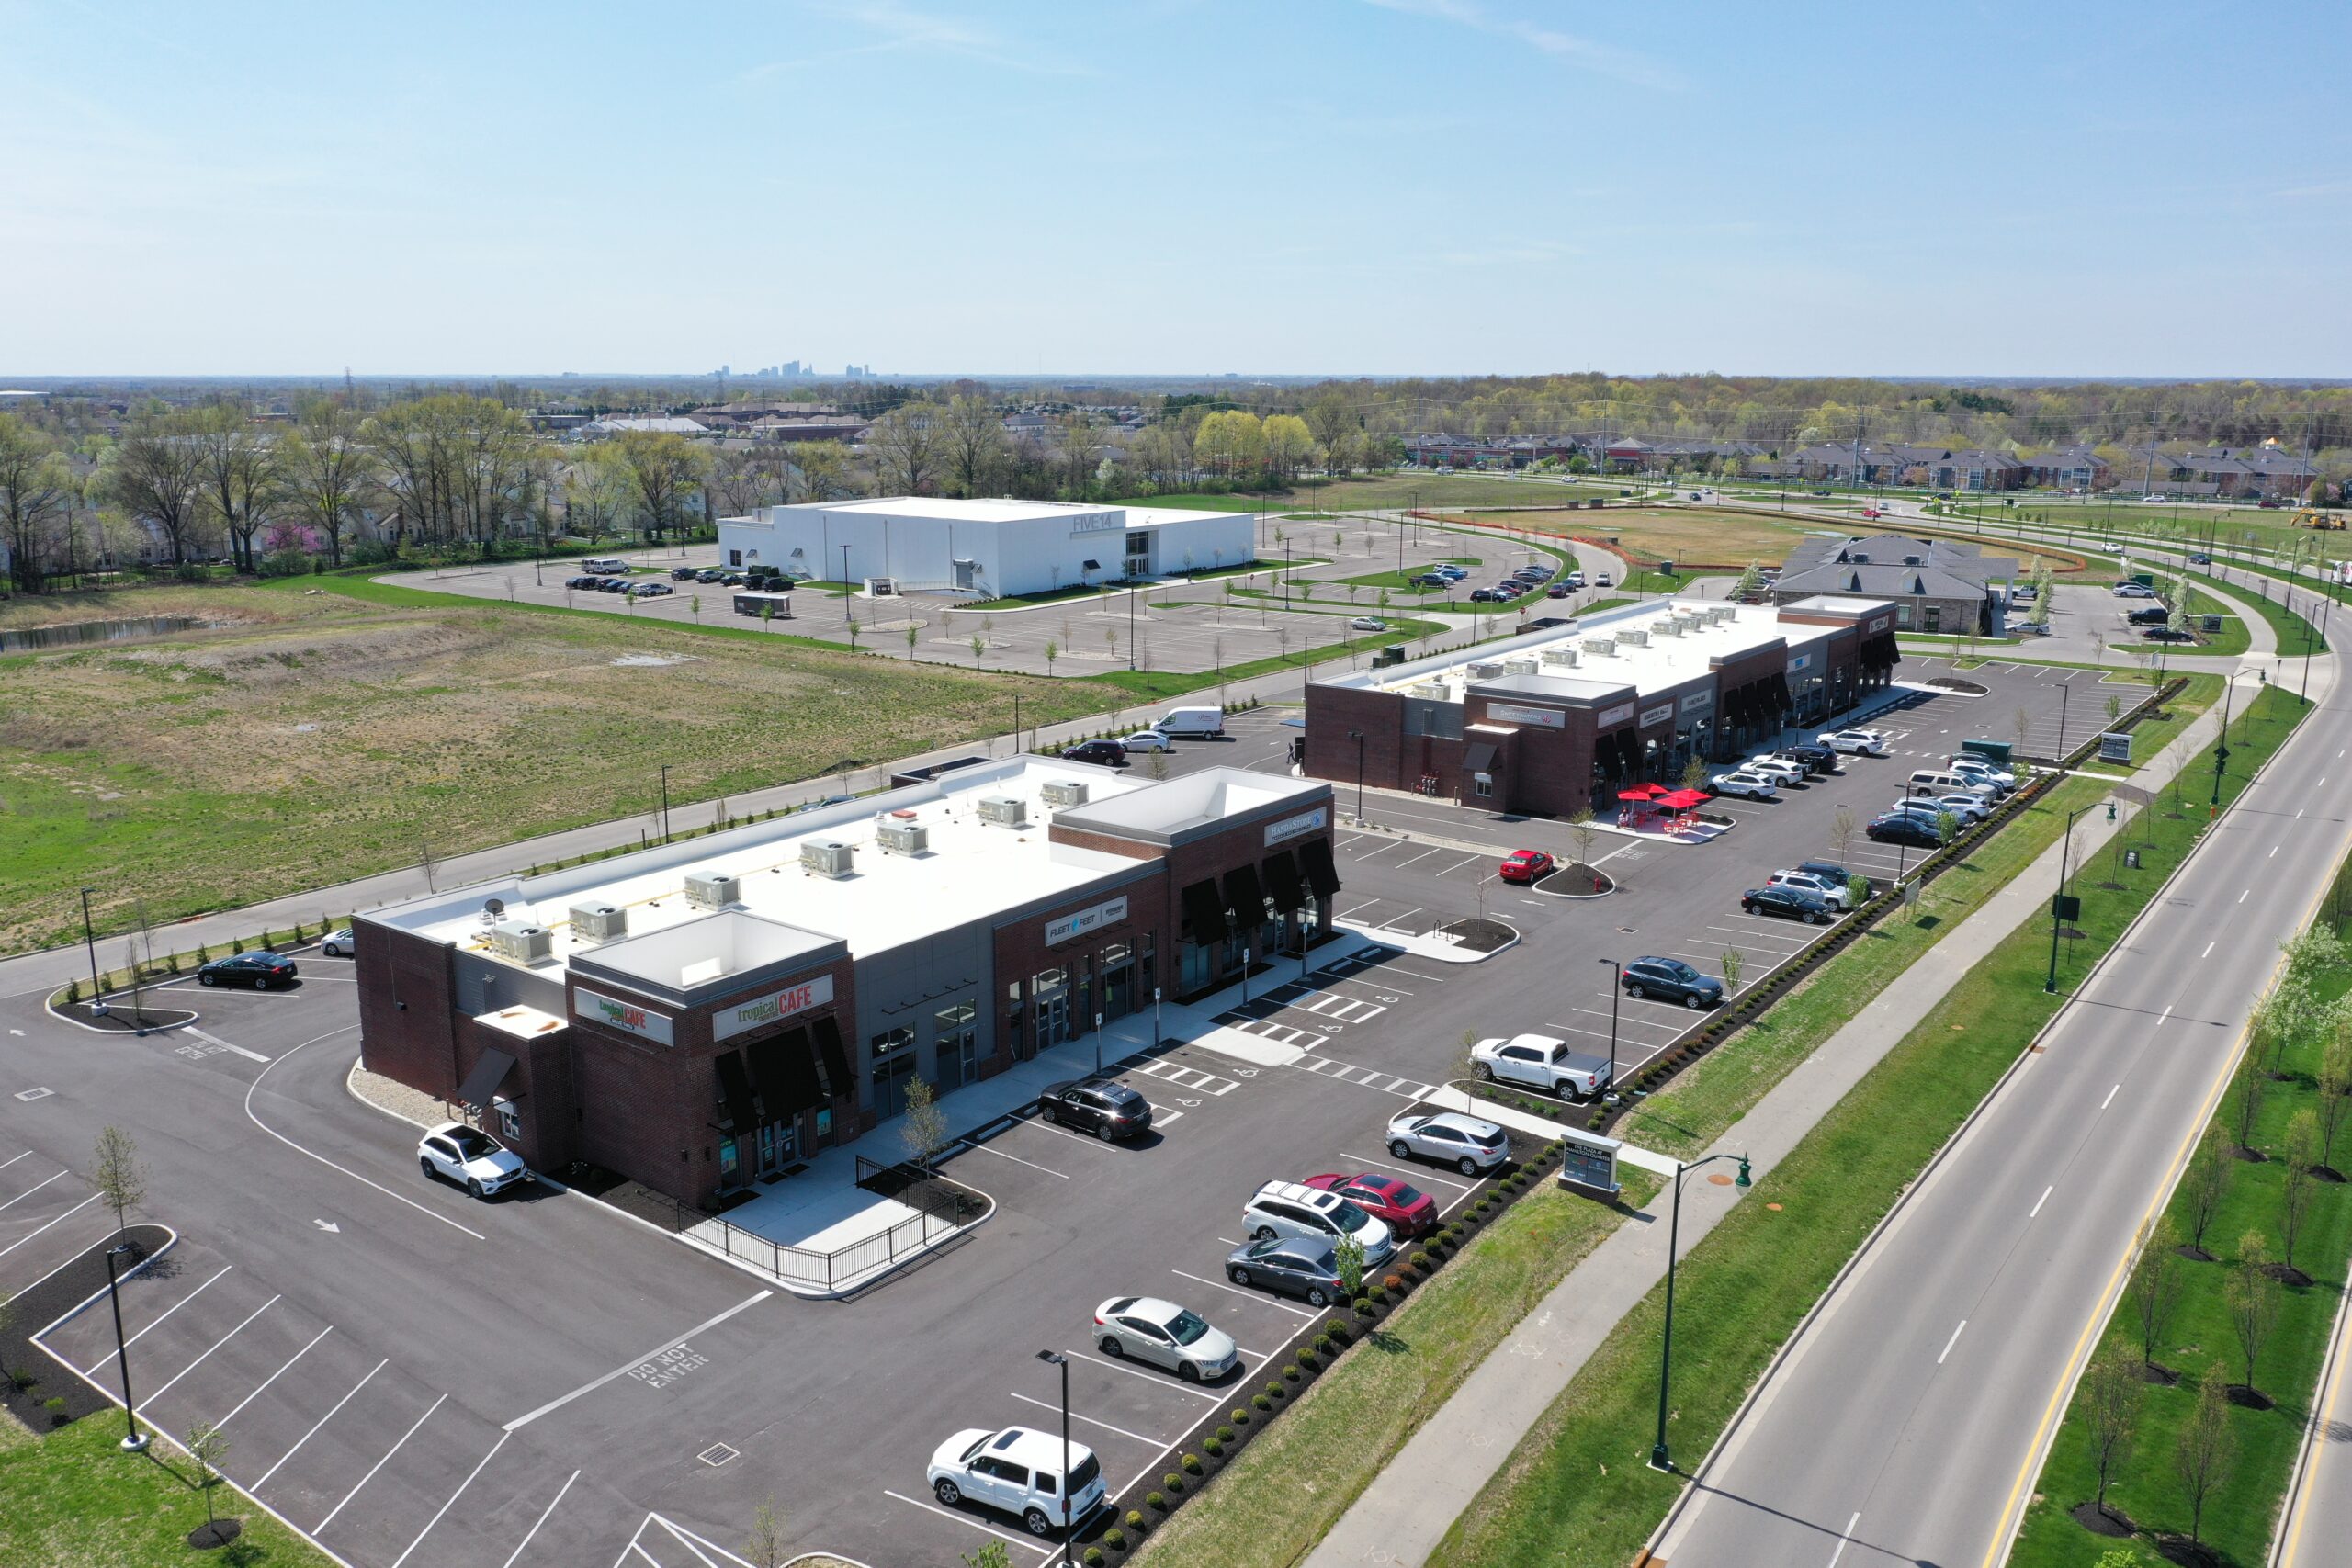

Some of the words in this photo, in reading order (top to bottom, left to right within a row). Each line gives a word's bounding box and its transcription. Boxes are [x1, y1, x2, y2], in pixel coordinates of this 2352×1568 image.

[1073, 513, 1112, 532] FIVE14
[1050, 923, 1070, 938] FLEET
[1079, 915, 1095, 928] FEET
[738, 997, 779, 1022] tropical
[779, 985, 812, 1015] CAFE
[624, 1007, 646, 1030] CAFE
[628, 1363, 658, 1381] DO
[655, 1342, 694, 1366] NOT
[646, 1354, 710, 1389] ENTER
